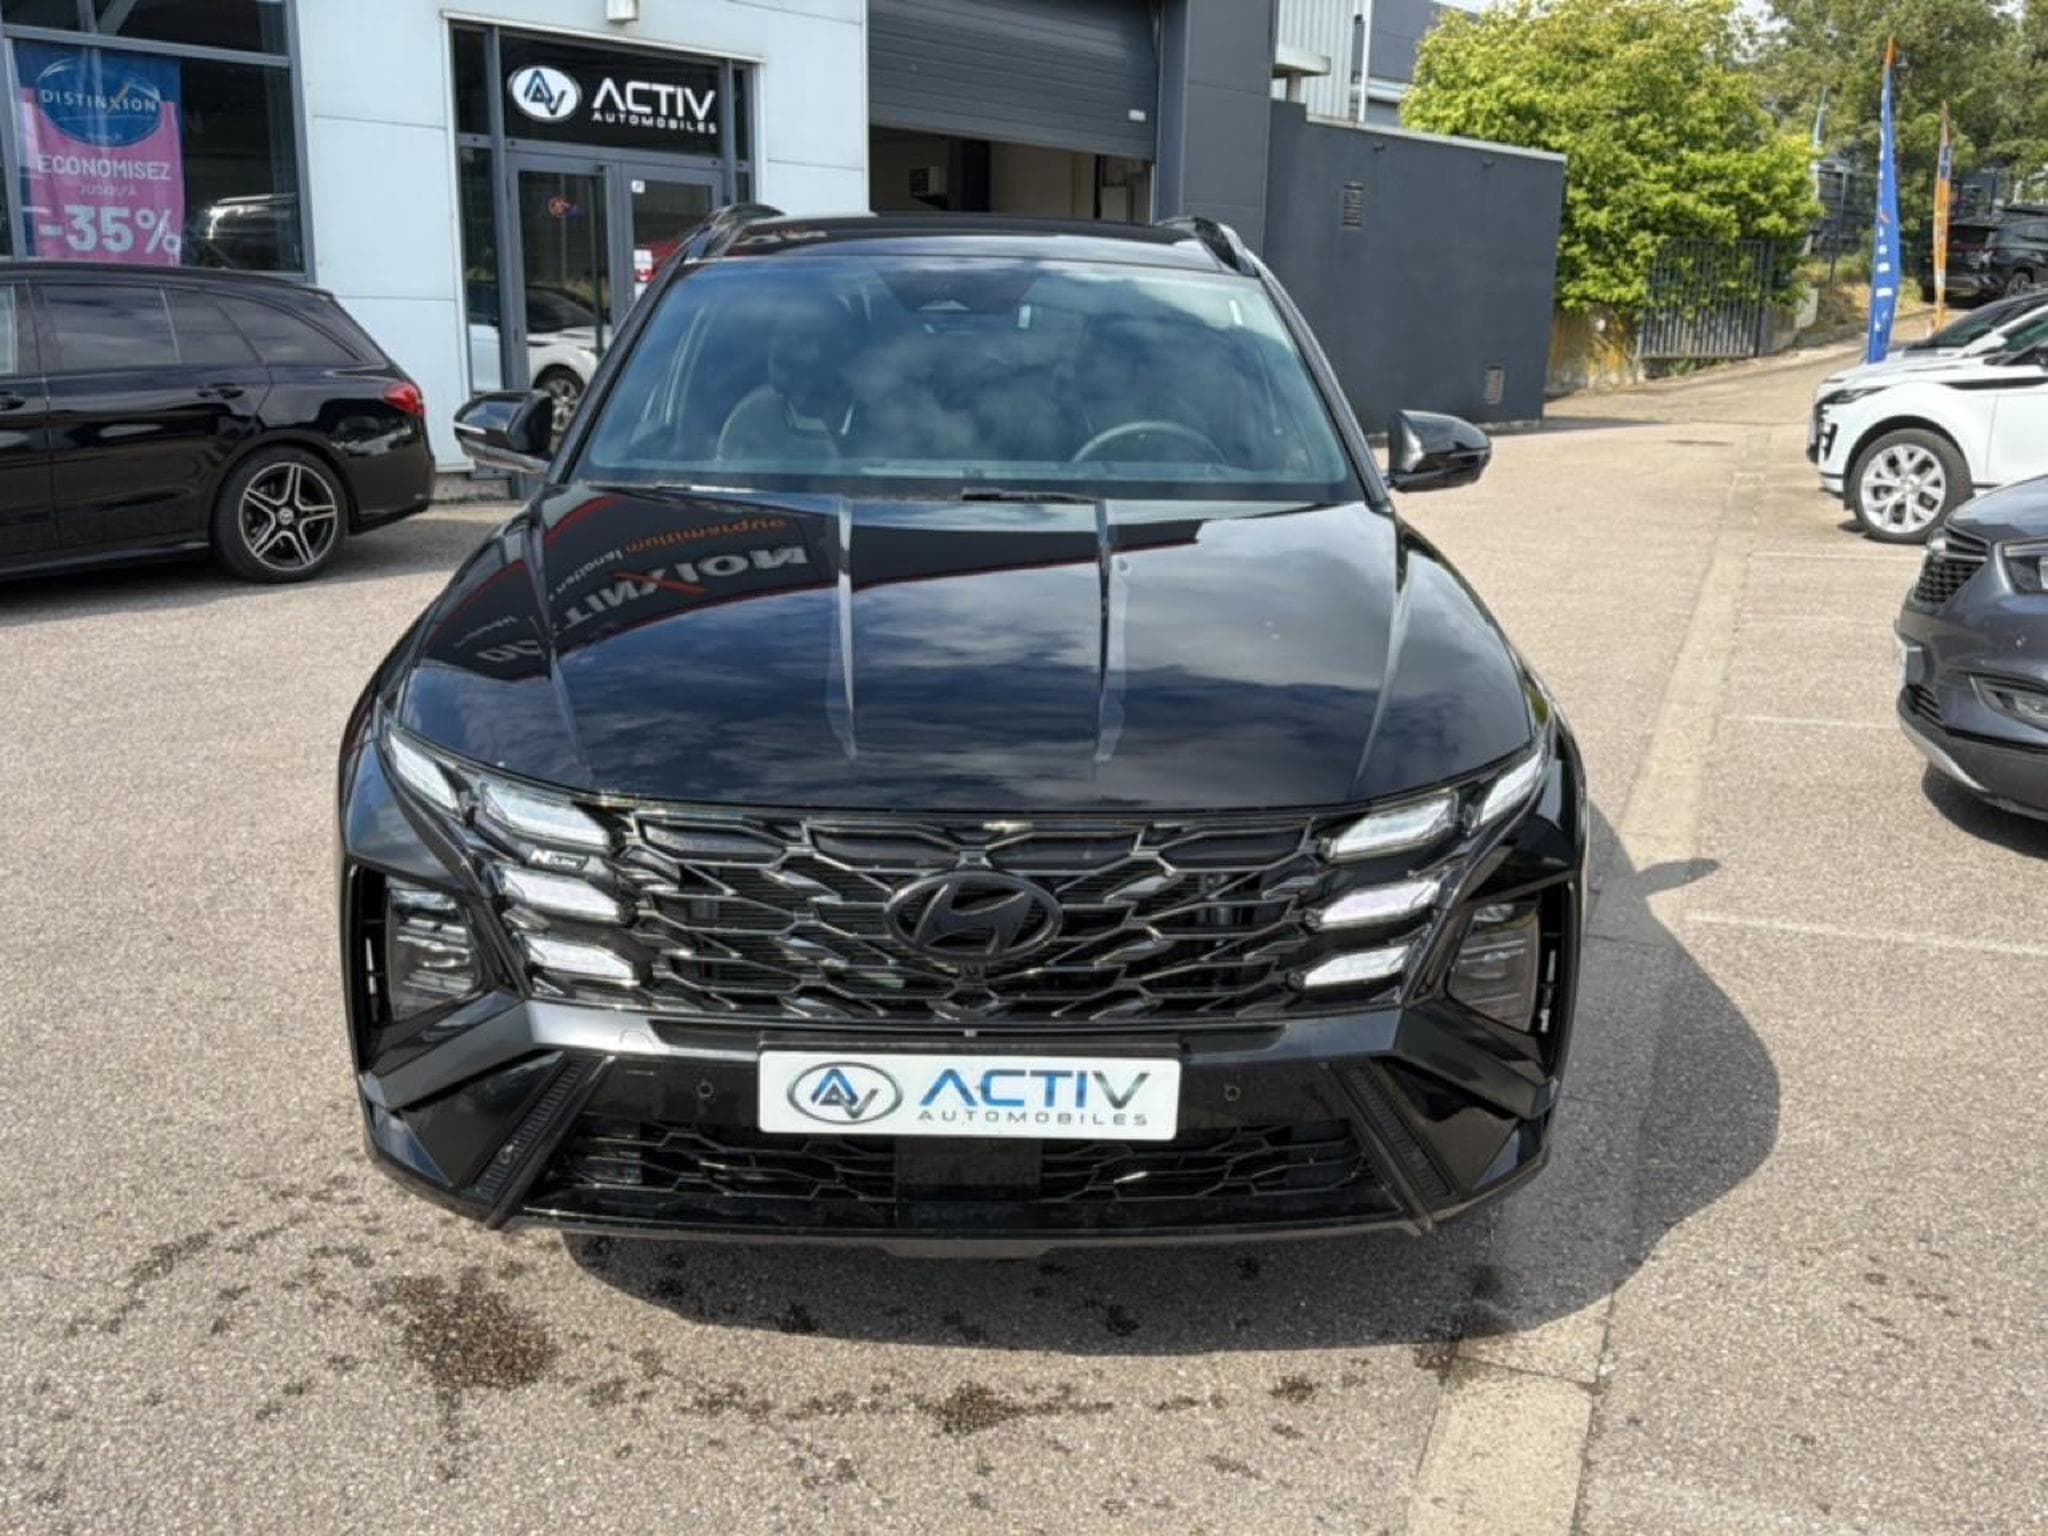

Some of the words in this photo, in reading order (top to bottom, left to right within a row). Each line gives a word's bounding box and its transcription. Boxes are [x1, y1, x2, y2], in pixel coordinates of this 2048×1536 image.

[40, 83, 159, 112] DISTINXION
[592, 77, 716, 121] ACTIV
[592, 111, 718, 135] AUTOMOBILES
[38, 203, 182, 257] -35%
[919, 1068, 1151, 1110] ACTIV
[918, 1109, 1149, 1127] AUTOMOBILES
